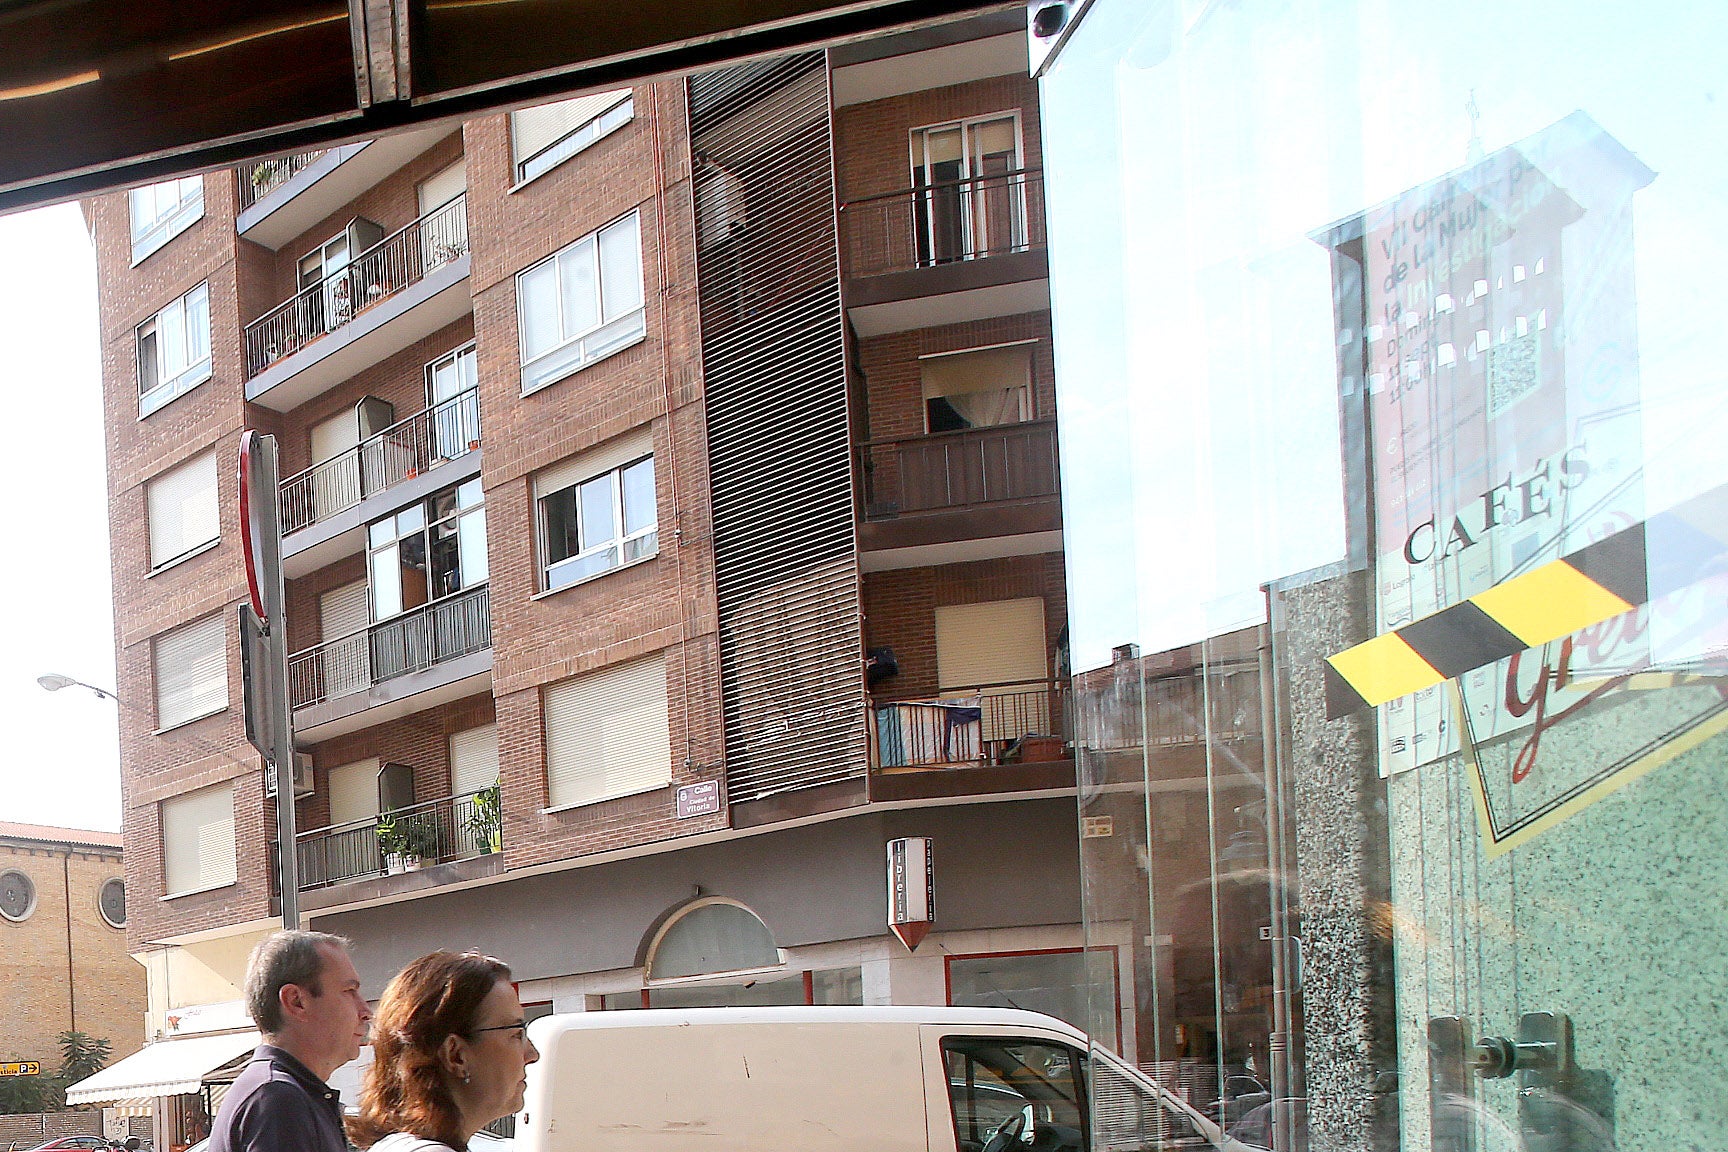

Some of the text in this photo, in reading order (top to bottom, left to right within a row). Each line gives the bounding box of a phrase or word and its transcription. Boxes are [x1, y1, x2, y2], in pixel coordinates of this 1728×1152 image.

[1404, 444, 1590, 565] CAFÉS
[694, 785, 713, 795] Calle
[686, 803, 711, 813] Vitoria
[20, 1064, 28, 1073] P
